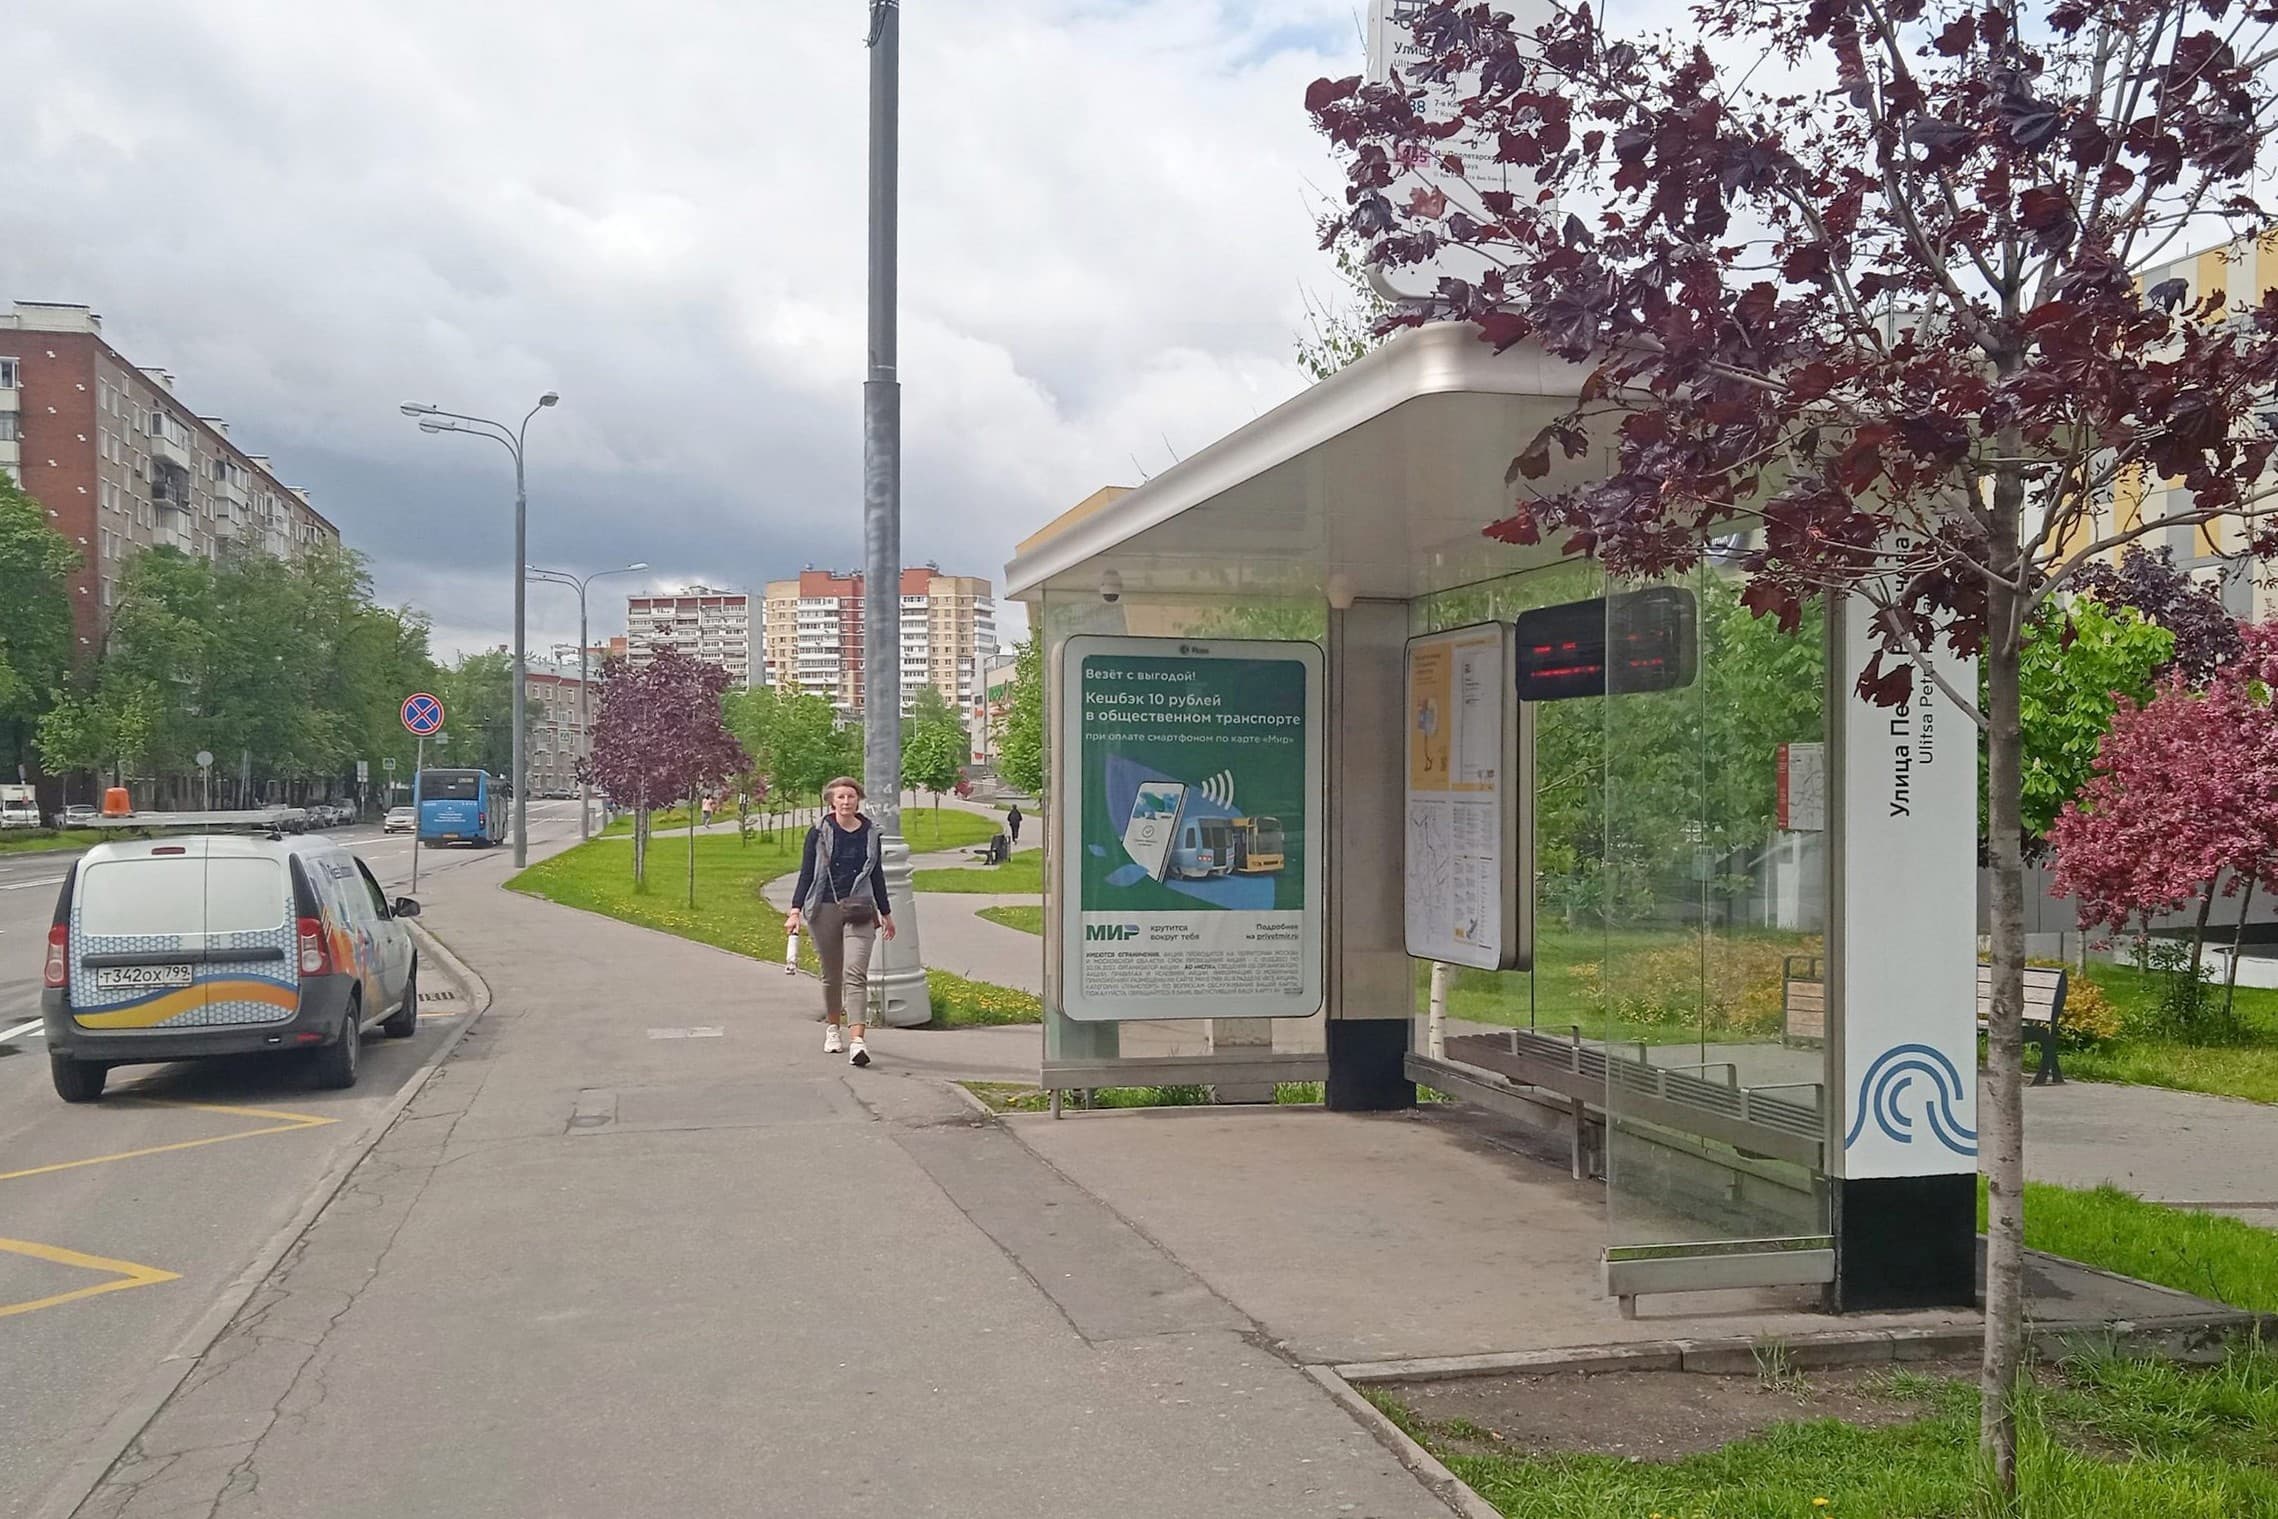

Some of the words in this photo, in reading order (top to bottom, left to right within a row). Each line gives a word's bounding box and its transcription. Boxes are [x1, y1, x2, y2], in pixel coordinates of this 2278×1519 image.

[1085, 668, 1123, 680] Везёт
[1126, 672, 1135, 680] с
[1137, 671, 1196, 682] выгодой!
[1086, 691, 1145, 705] Кешбэк
[1149, 693, 1164, 705] 10
[1168, 693, 1221, 708] рублей
[1086, 711, 1095, 721] в
[1098, 709, 1211, 723] общественном
[1215, 713, 1301, 726] транспорте
[1085, 732, 1106, 742] при
[1108, 733, 1145, 741] оплате
[1147, 734, 1213, 743] смартфоном
[1215, 735, 1229, 743] по
[1231, 735, 1261, 744] карте
[1919, 714, 1933, 764] Ulitsa
[1890, 745, 1912, 817] Улица
[1086, 924, 1140, 941] МИР
[1150, 925, 1188, 933] крутится
[1150, 934, 1178, 942] вокруг
[1181, 932, 1200, 941] тебя
